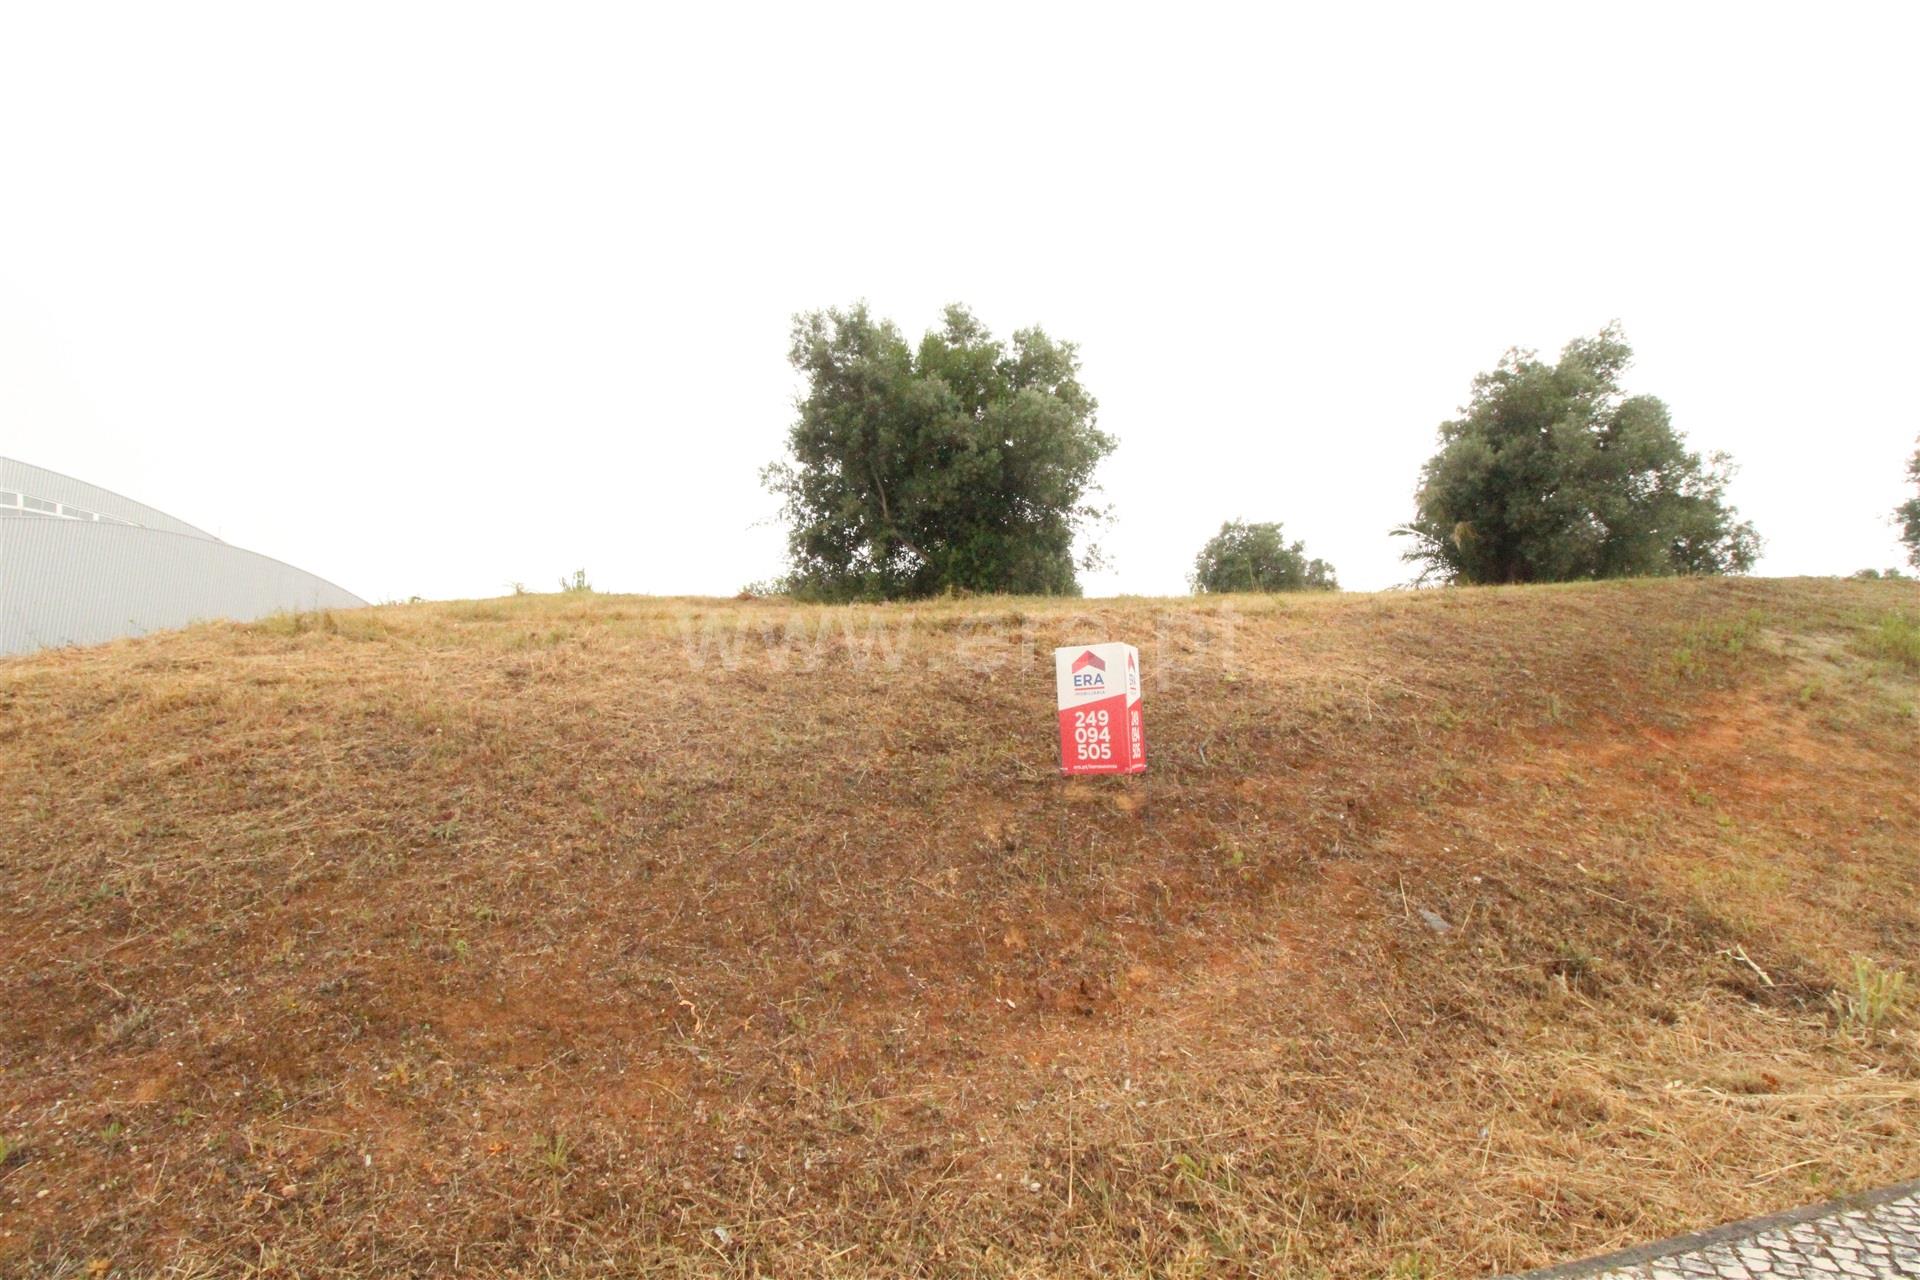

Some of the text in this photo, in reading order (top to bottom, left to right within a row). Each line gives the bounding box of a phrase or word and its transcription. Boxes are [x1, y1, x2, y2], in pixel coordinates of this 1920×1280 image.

[1074, 673, 1104, 687] ERA
[1075, 710, 1109, 727] 249
[1075, 727, 1111, 744] 094
[1077, 743, 1112, 760] 505
